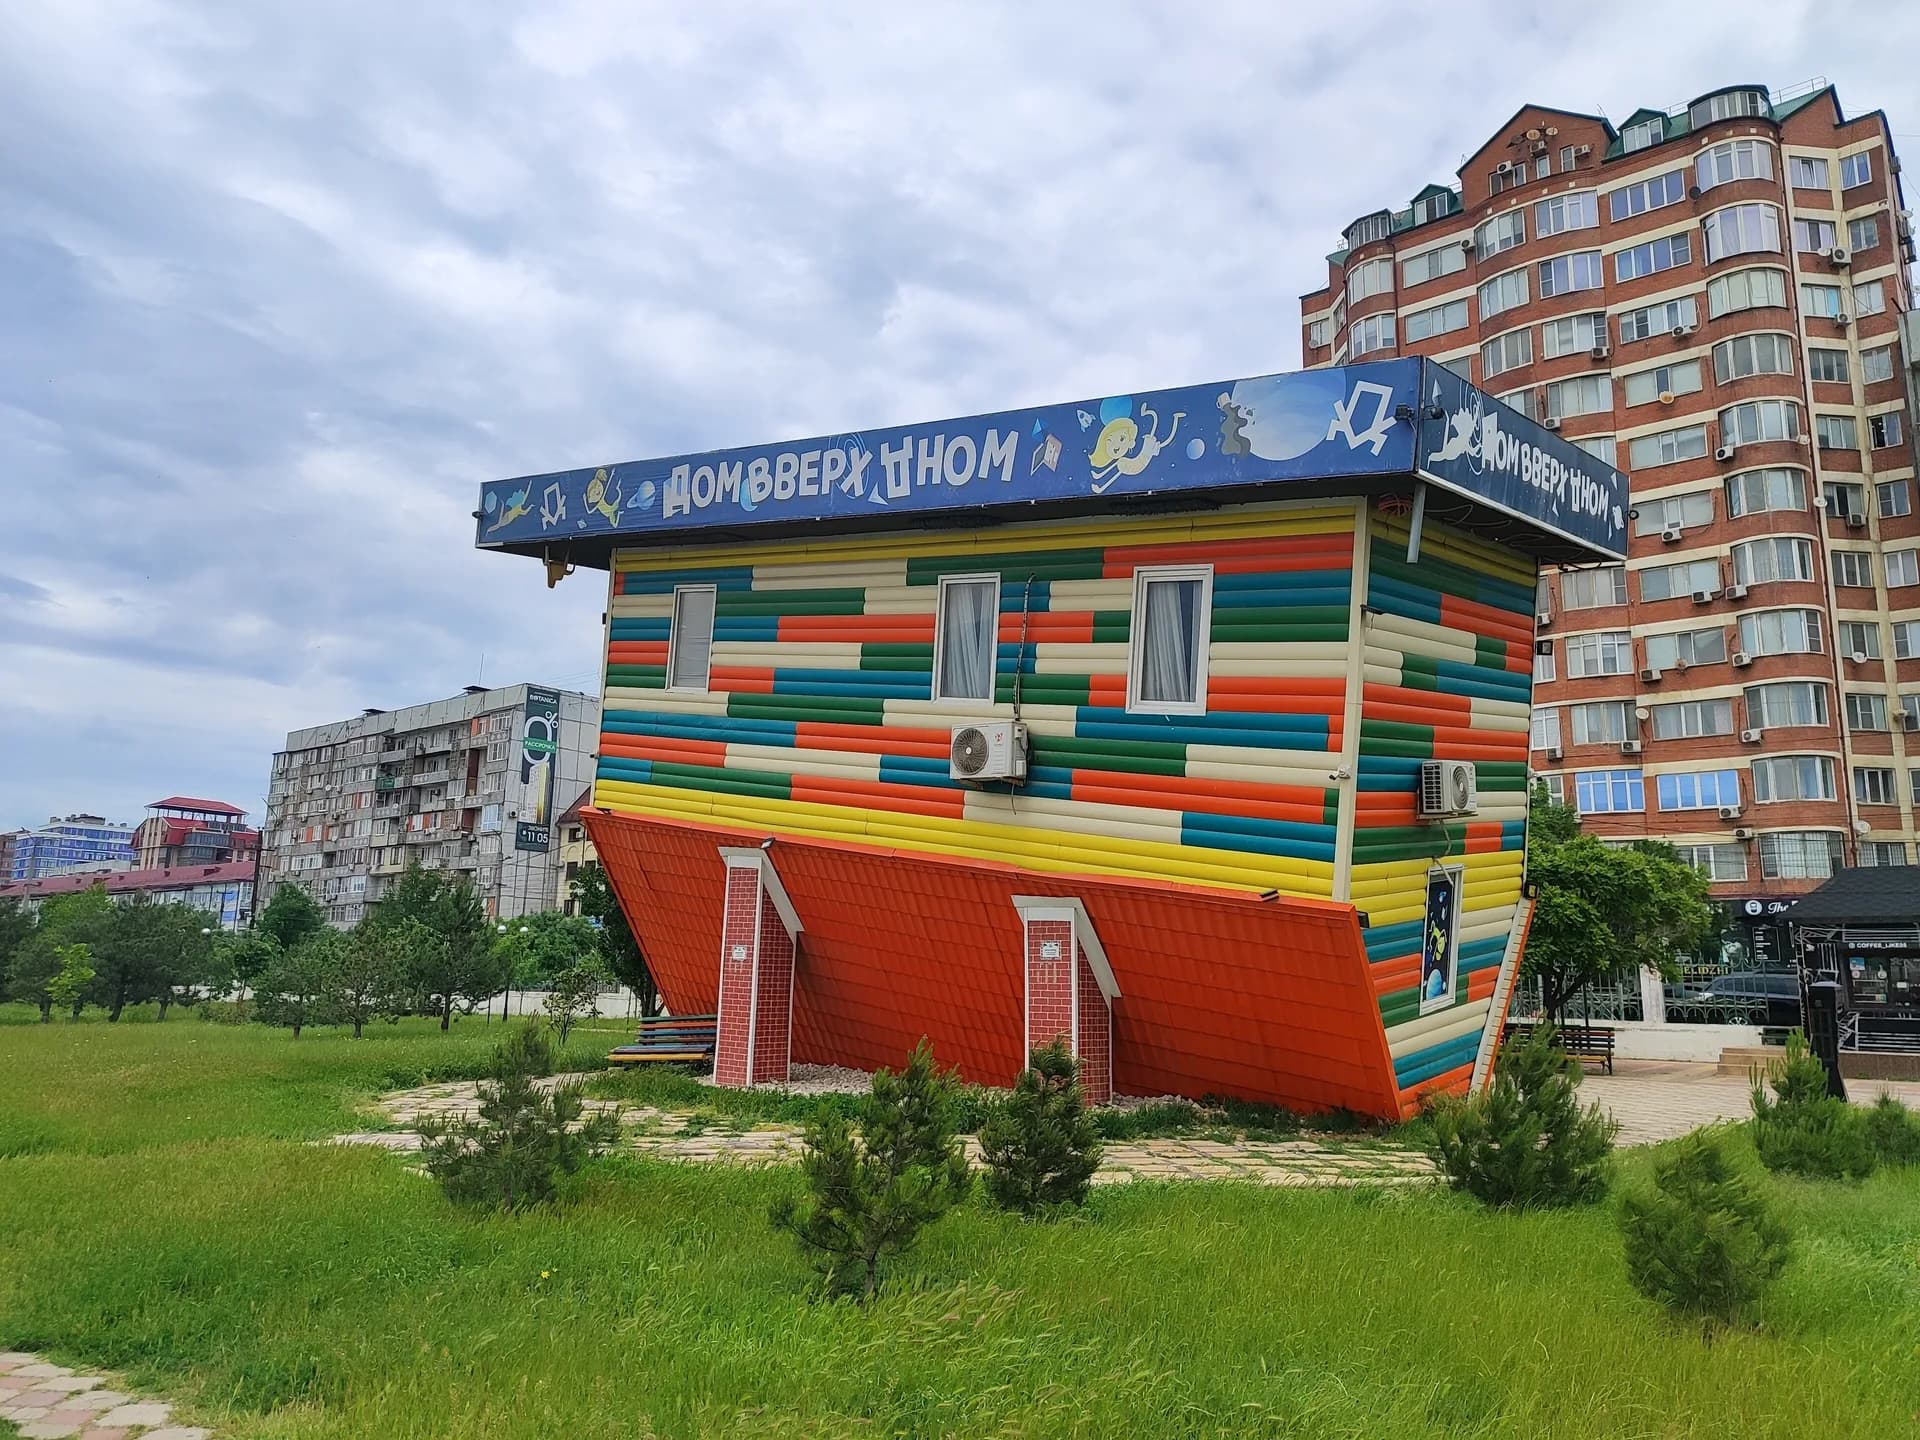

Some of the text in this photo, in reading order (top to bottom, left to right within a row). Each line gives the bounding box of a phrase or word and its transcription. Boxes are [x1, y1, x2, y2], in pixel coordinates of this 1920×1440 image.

[664, 429, 1019, 520] ДОМ ВВЕРХ ДНОМ
[1482, 412, 1610, 522] ДОМ ВВЕРХ ДНОМ
[525, 740, 555, 750] РАССРОЧКА
